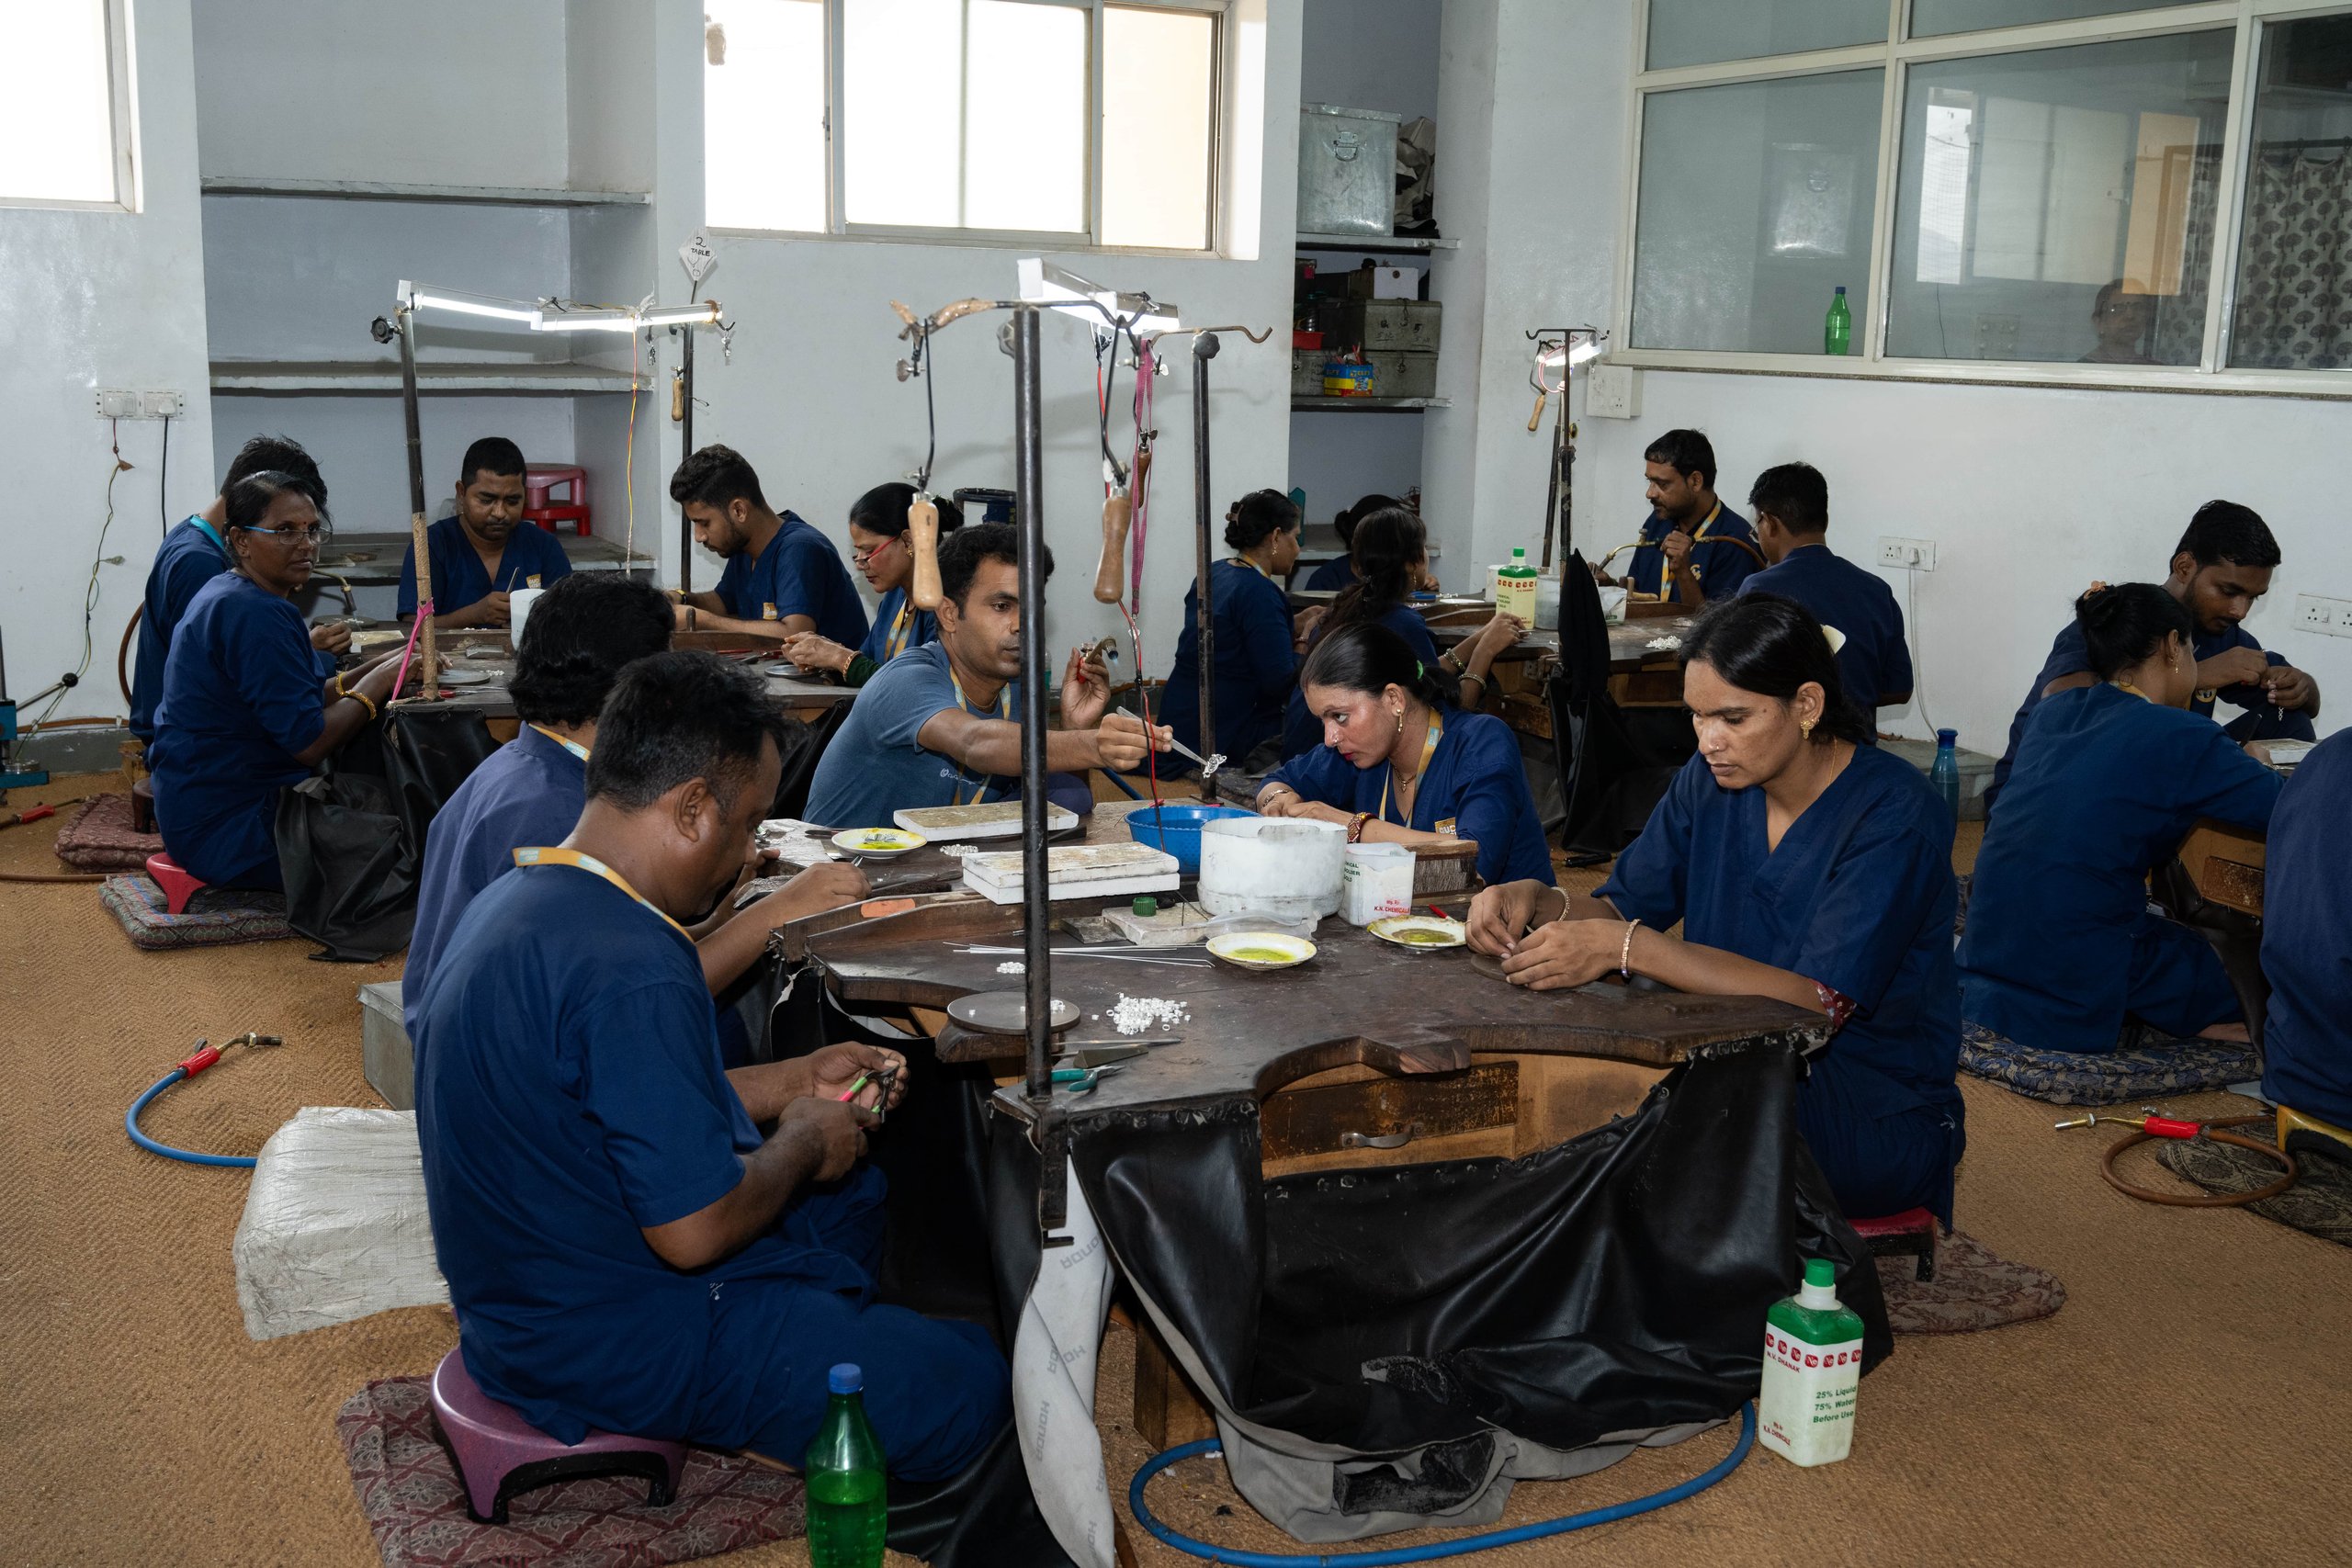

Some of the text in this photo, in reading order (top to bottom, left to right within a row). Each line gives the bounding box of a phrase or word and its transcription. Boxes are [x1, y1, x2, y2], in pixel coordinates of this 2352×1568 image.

[695, 236, 707, 248] 2
[691, 247, 711, 257] TABLE
[1815, 1385, 1857, 1399] 25% Liquid
[1815, 1398, 1855, 1411] 75% Water
[1813, 1411, 1854, 1423] Before Use
